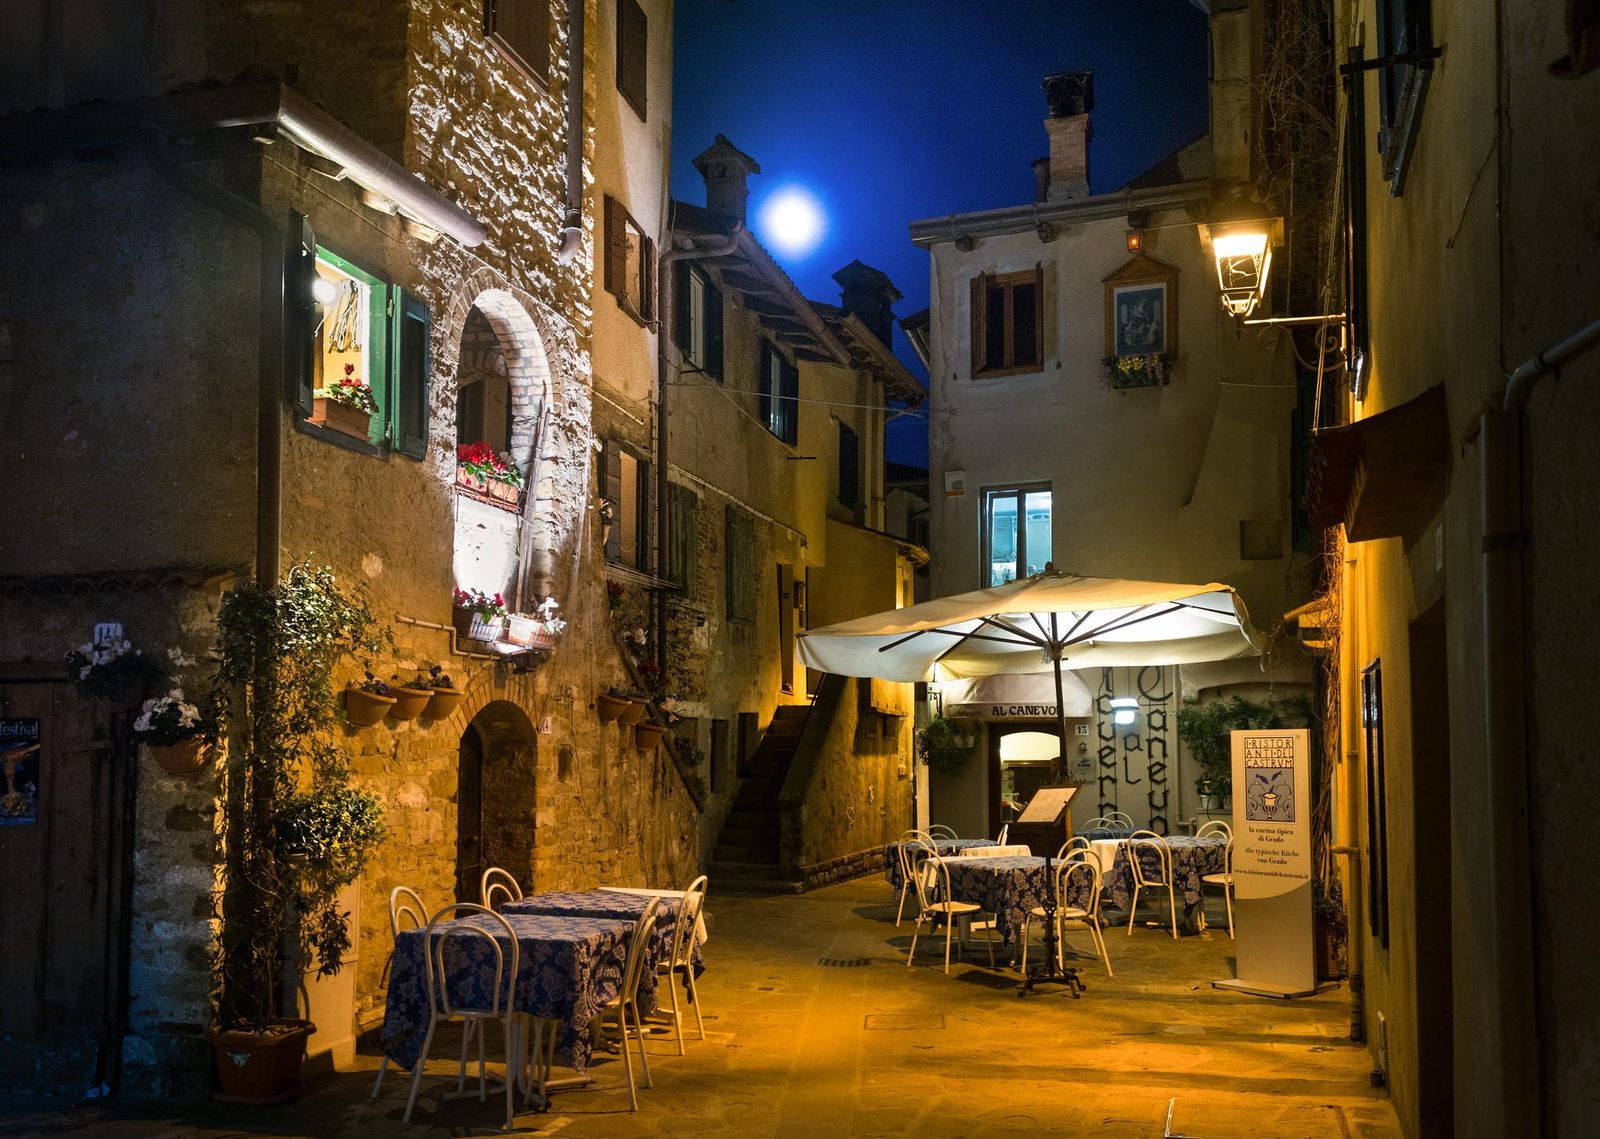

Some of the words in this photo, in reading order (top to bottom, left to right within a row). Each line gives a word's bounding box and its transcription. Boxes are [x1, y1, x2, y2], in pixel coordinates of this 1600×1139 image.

[992, 705, 1007, 716] AL
[1009, 705, 1059, 716] CANEVO
[0, 720, 39, 736] festival
[1276, 827, 1294, 836] tipica
[1265, 835, 1284, 843] Grado
[1255, 848, 1280, 856] typische
[1281, 849, 1300, 857] Küche
[1268, 857, 1288, 865] Grado
